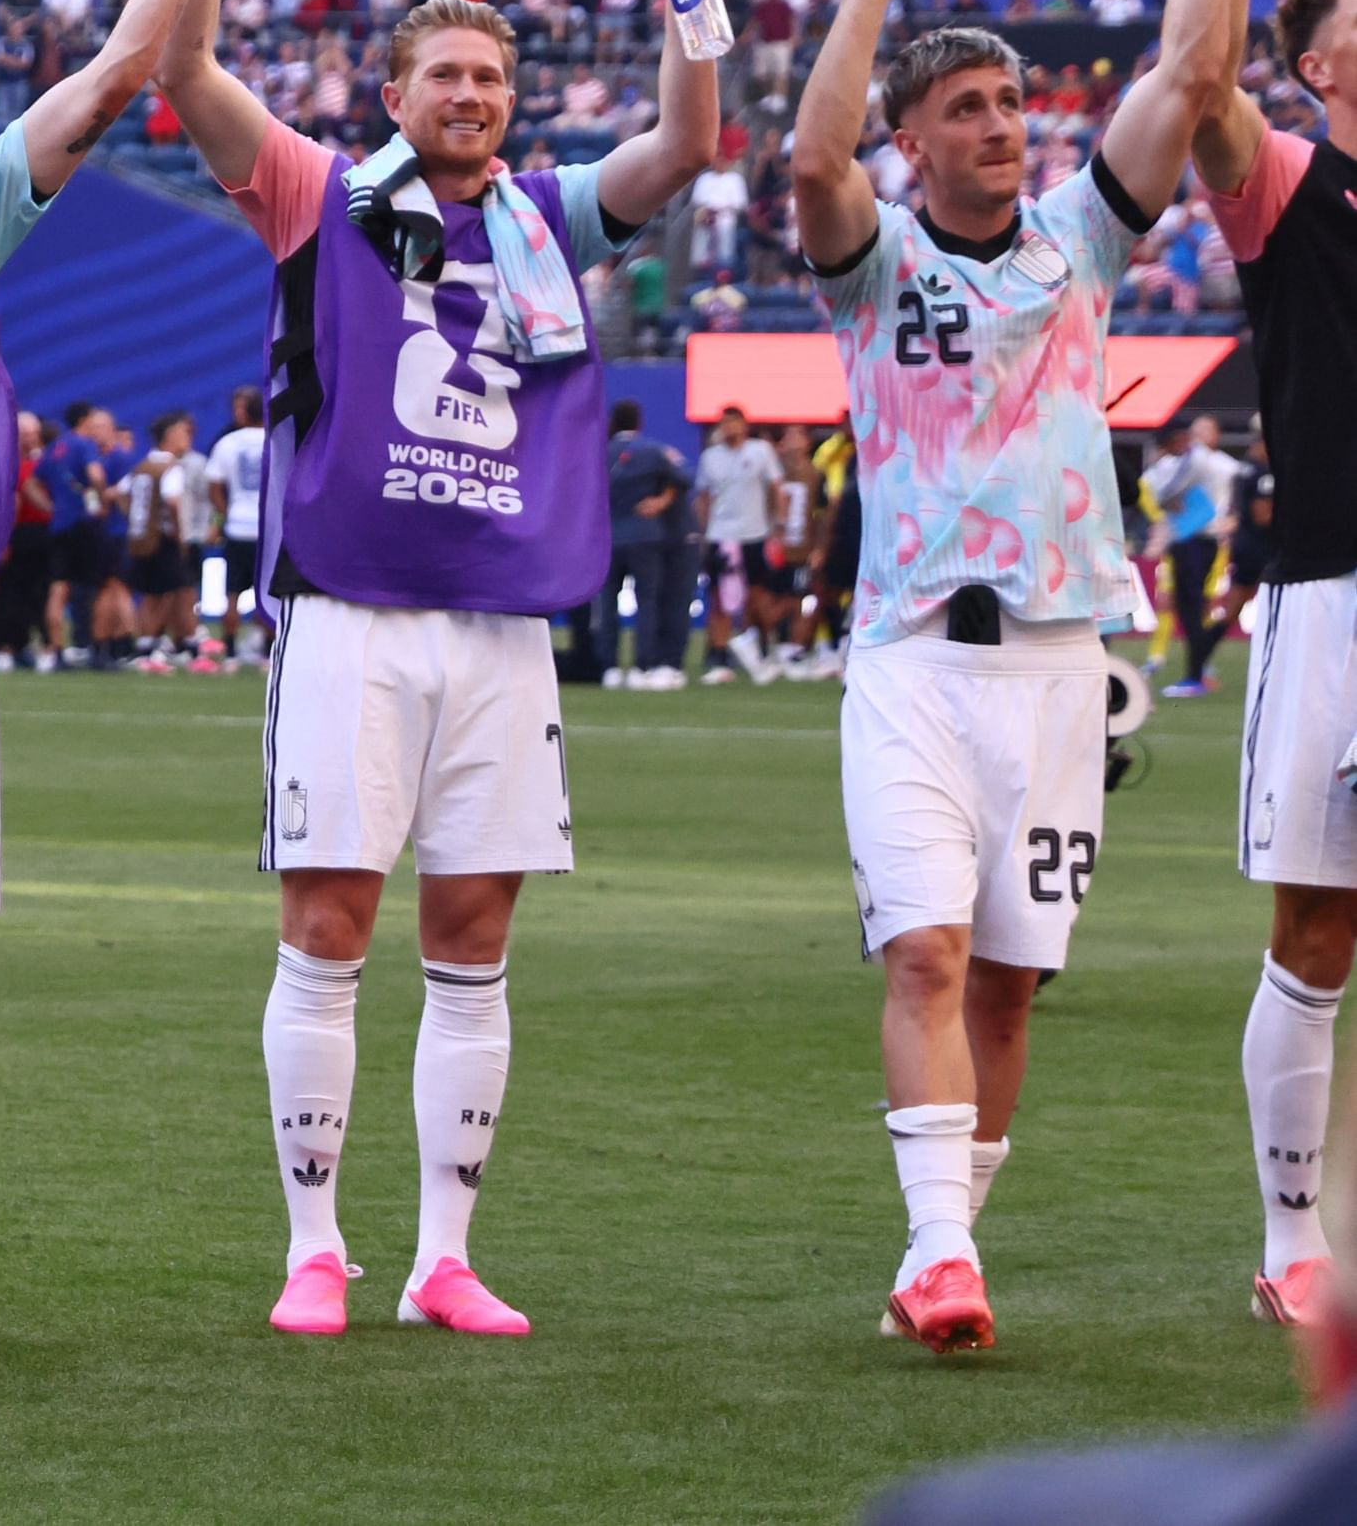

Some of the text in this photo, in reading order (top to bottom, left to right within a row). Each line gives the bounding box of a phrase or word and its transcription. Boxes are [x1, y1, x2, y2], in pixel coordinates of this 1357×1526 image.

[896, 290, 973, 367] 22
[435, 395, 489, 429] FIFA
[388, 443, 520, 483] WORLD CUP
[382, 468, 524, 515] 2026
[1028, 827, 1094, 905] 22
[282, 1112, 343, 1131] RBFA
[1268, 1145, 1323, 1165] RBF
